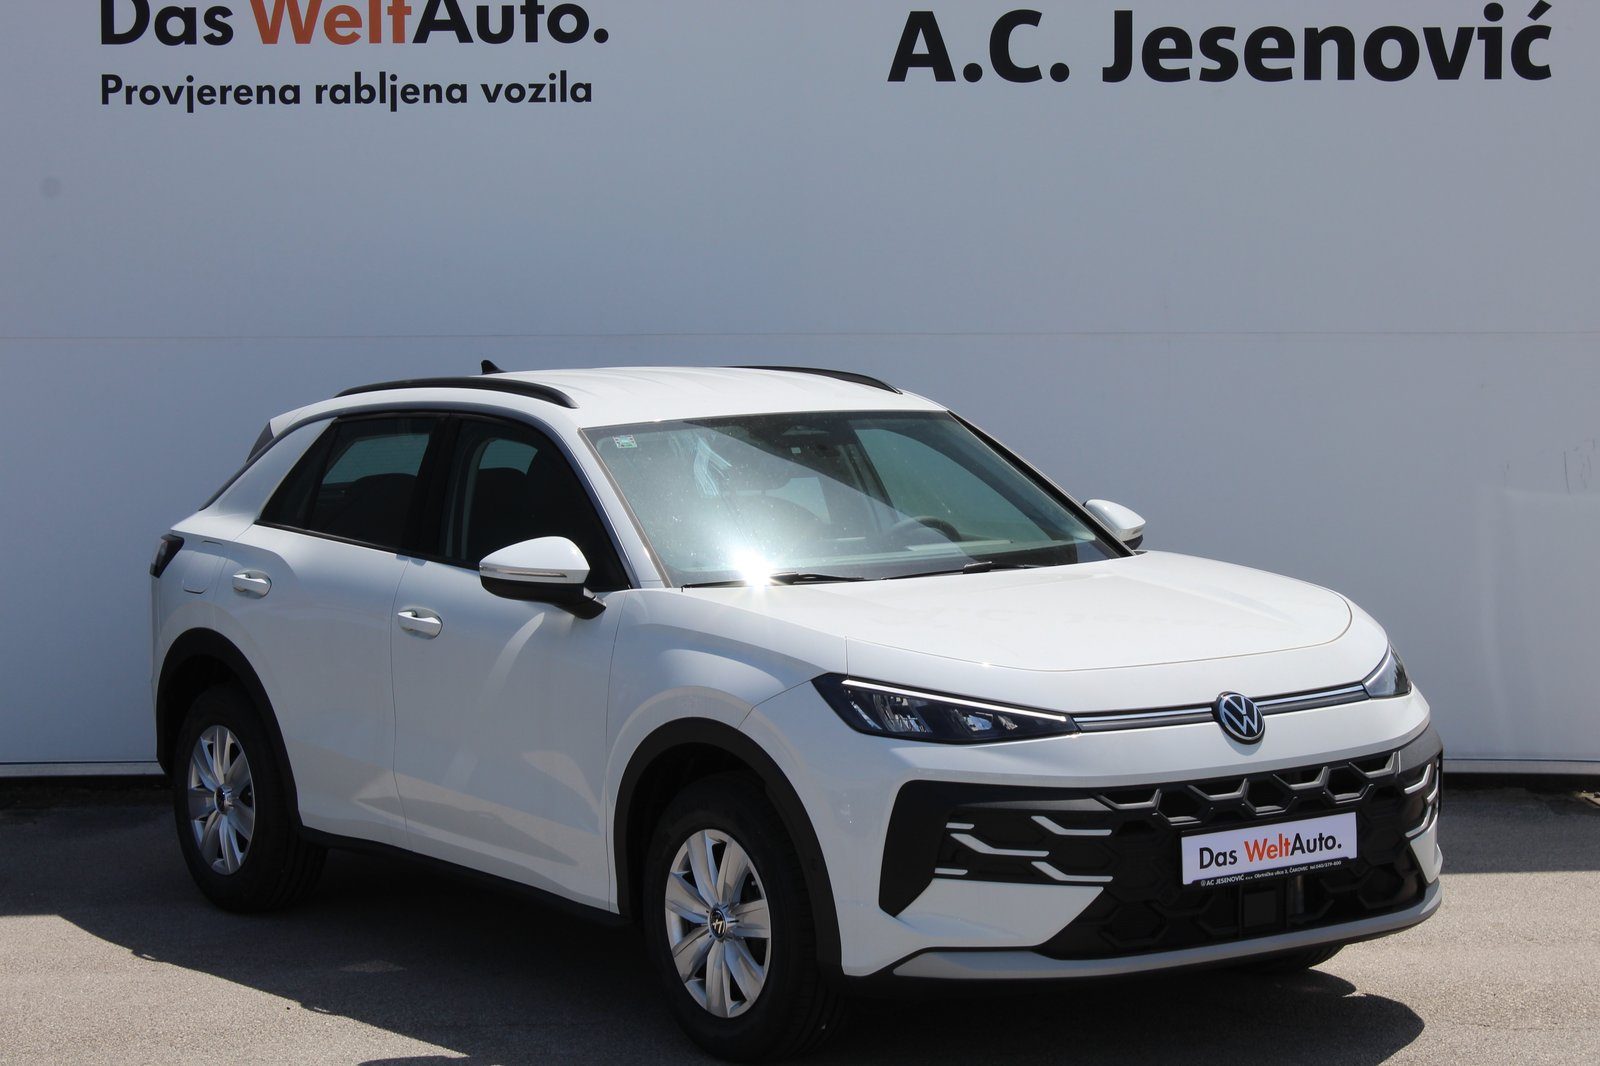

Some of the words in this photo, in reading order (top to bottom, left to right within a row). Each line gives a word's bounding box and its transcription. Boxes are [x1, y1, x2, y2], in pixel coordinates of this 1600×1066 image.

[101, 0, 234, 46] Das
[249, 0, 610, 45] WeltAuto.
[887, 8, 1070, 84] A.C.
[1102, 0, 1553, 84] Jesenović
[101, 73, 301, 114] Provjerena
[315, 70, 468, 113] rabljena
[480, 69, 592, 104] vozila
[1199, 846, 1238, 869] Das
[1243, 832, 1342, 863] WeltAuto.
[1206, 879, 1214, 887] AC
